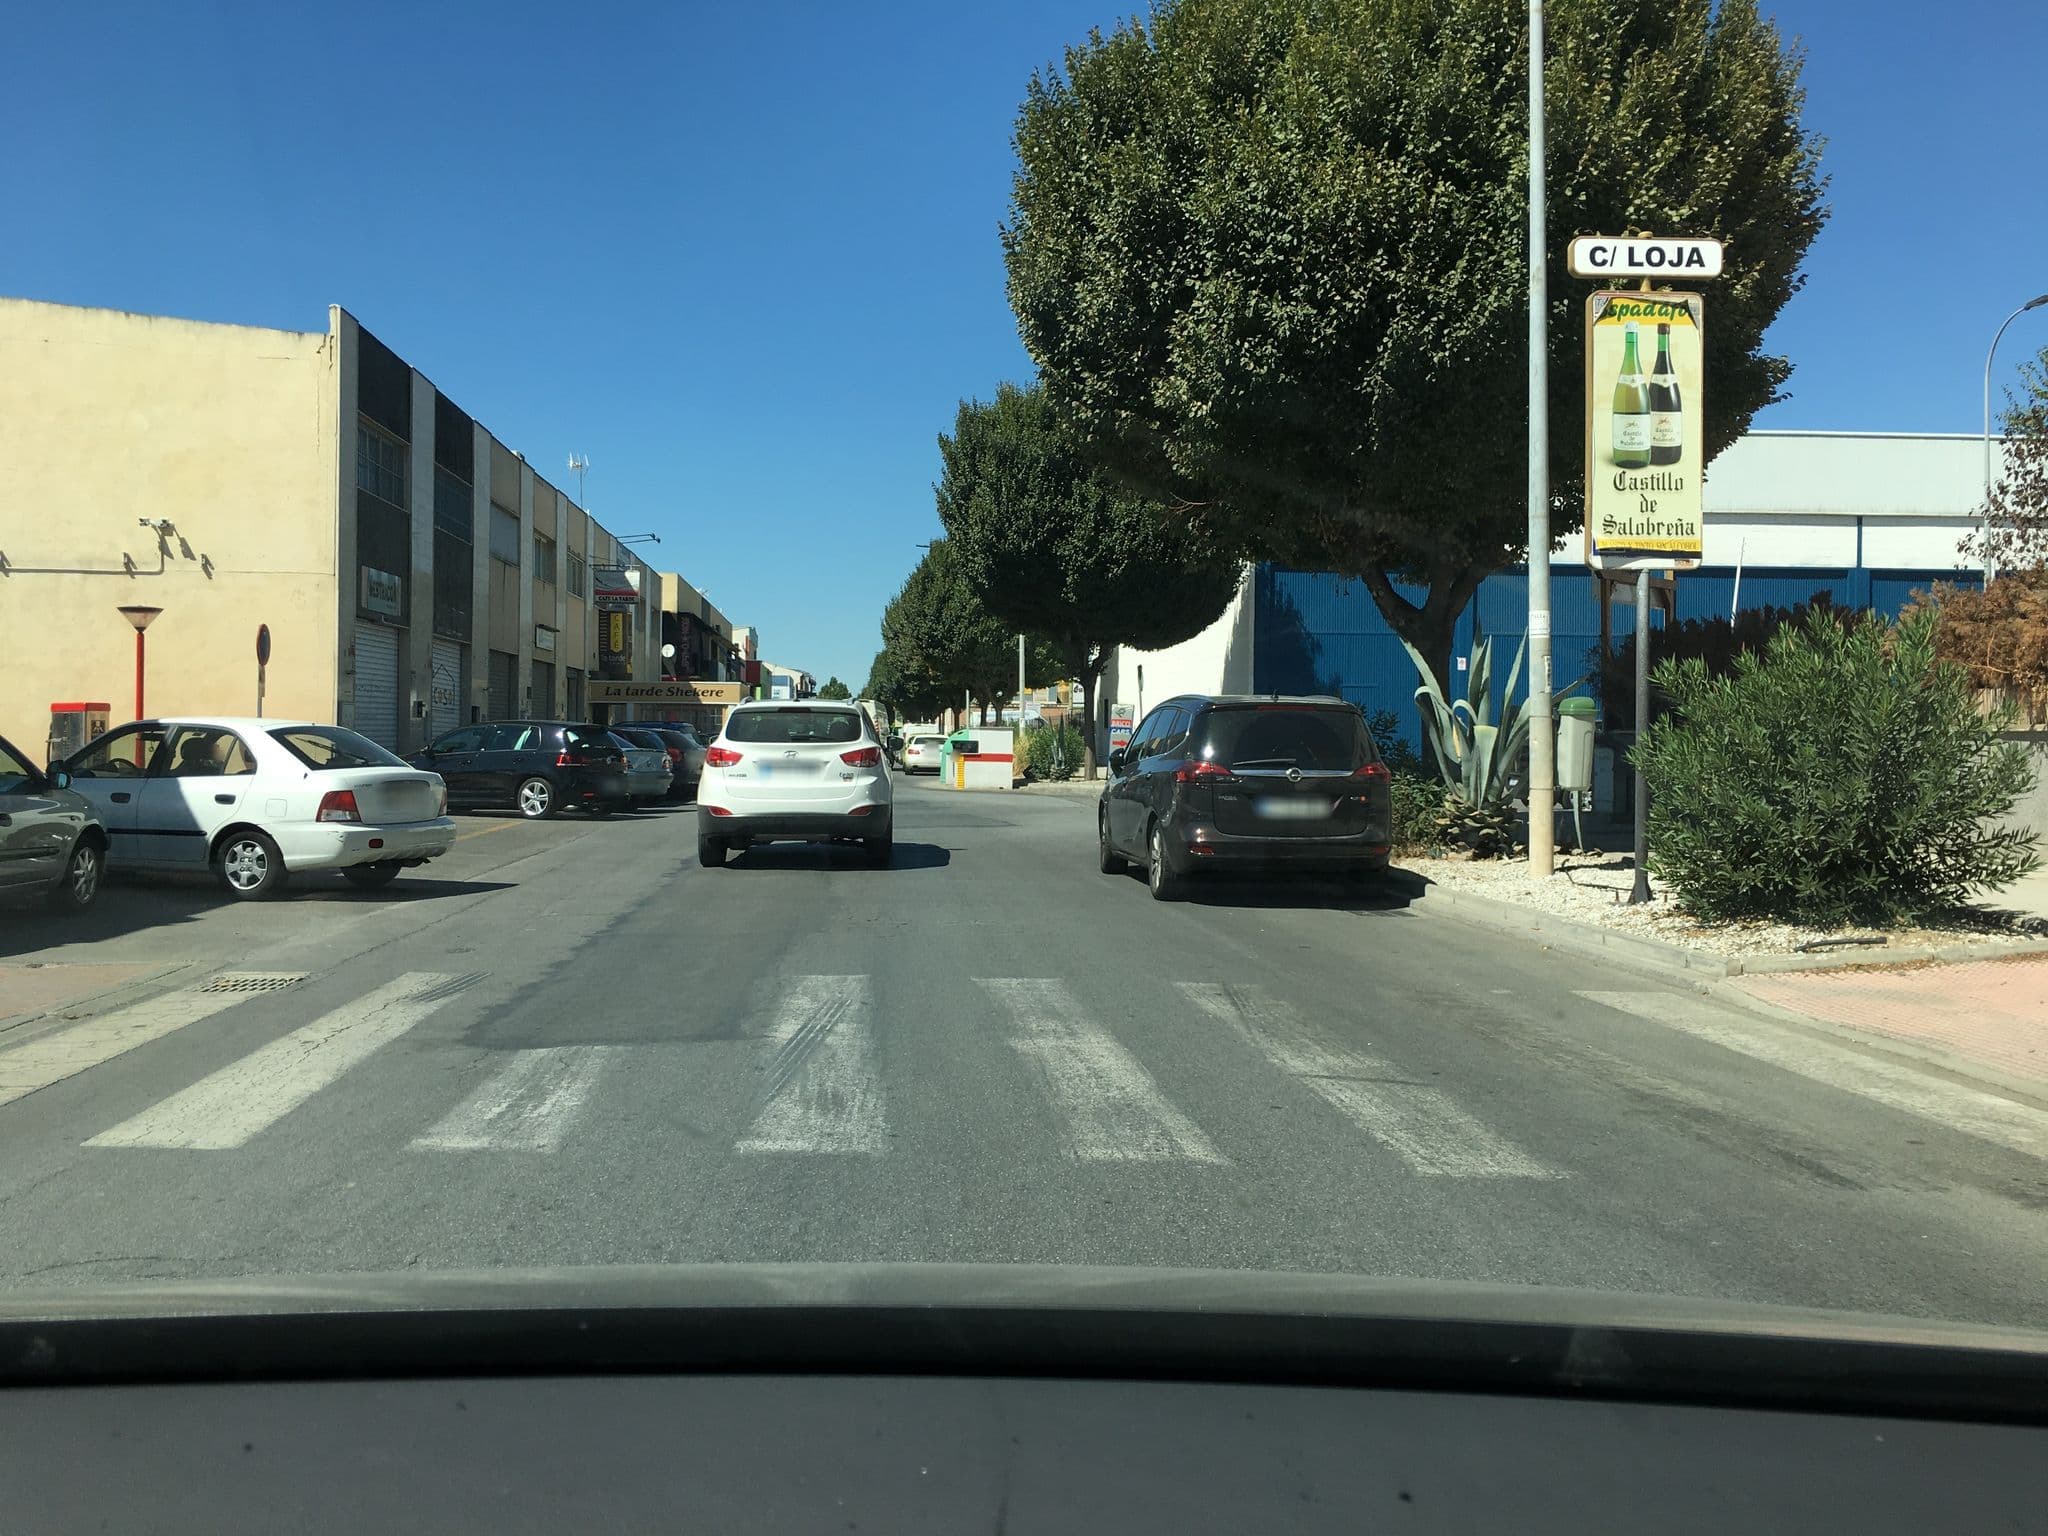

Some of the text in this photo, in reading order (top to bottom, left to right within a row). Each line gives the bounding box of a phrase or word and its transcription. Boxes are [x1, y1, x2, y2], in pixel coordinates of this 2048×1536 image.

[1589, 246, 1706, 267] C/ LOJA
[1613, 471, 1684, 492] Castillo
[1639, 494, 1658, 514] de
[1602, 514, 1696, 537] Salobreña
[605, 686, 725, 698] La tarde Shekere
